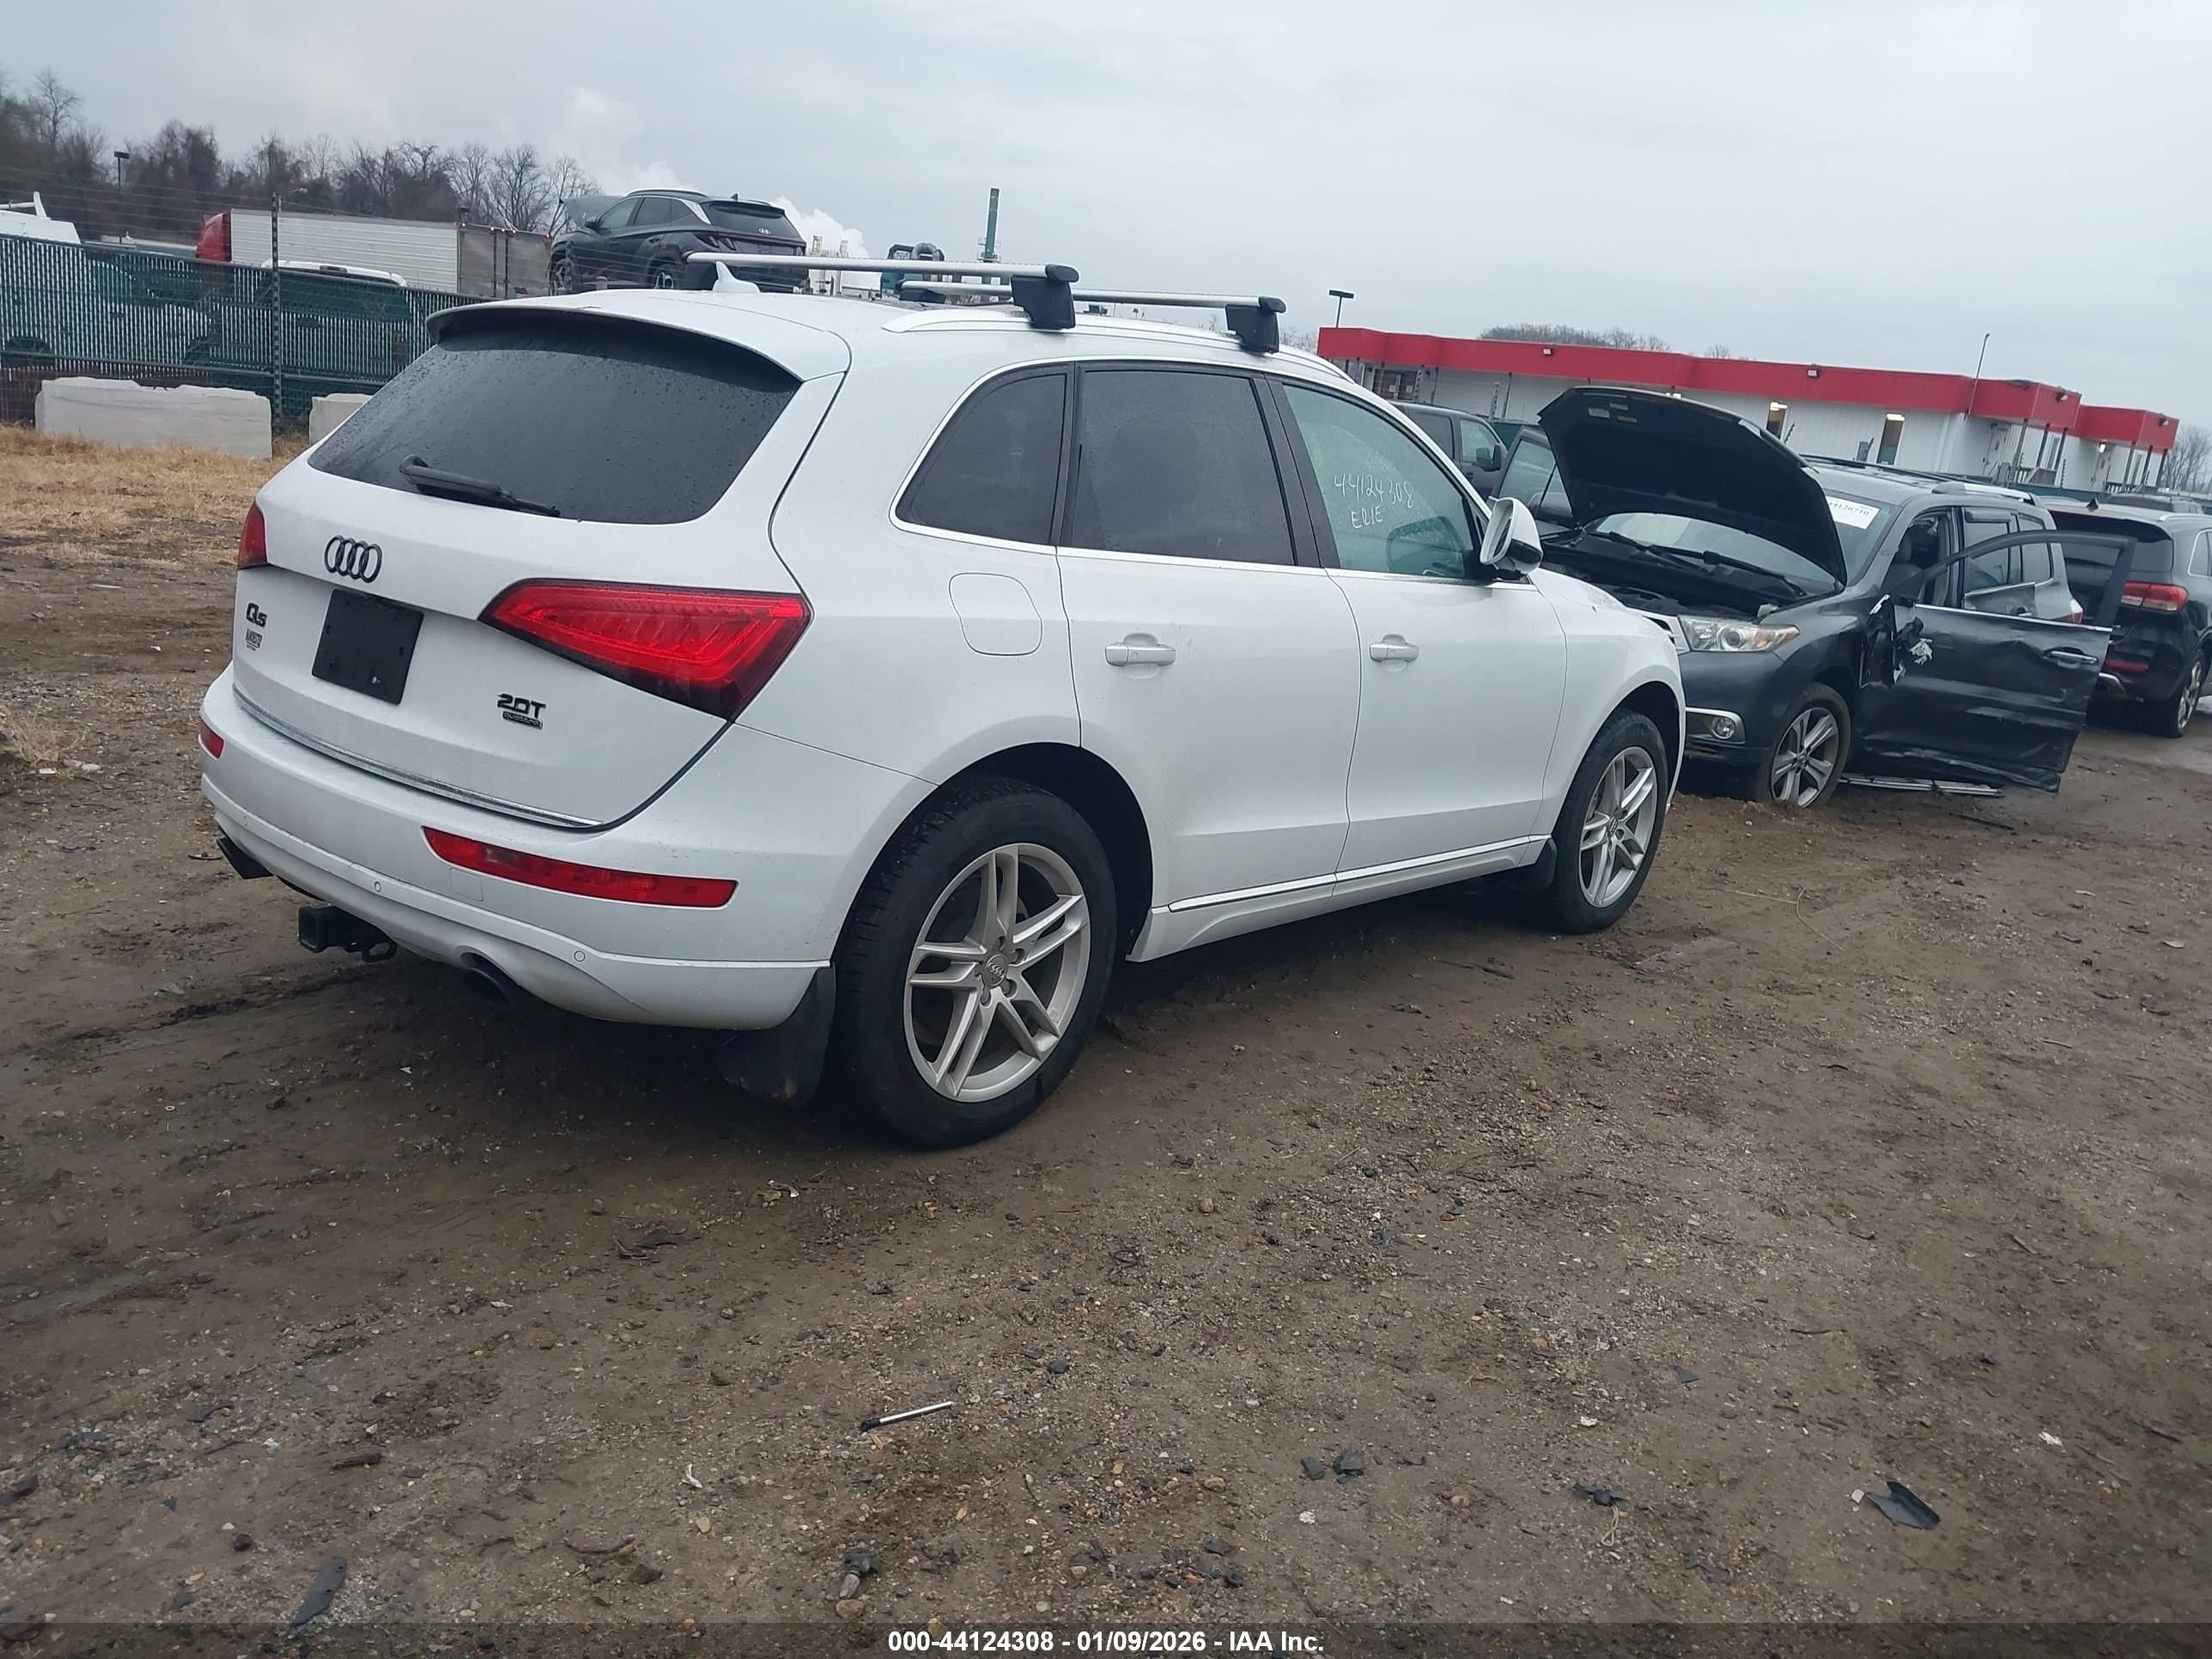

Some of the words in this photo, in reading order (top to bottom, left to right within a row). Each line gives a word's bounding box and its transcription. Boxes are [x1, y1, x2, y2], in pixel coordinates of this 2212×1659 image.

[1334, 474, 1414, 508] 44124308
[1351, 504, 1383, 529] ERIE
[246, 602, 268, 629] Q5
